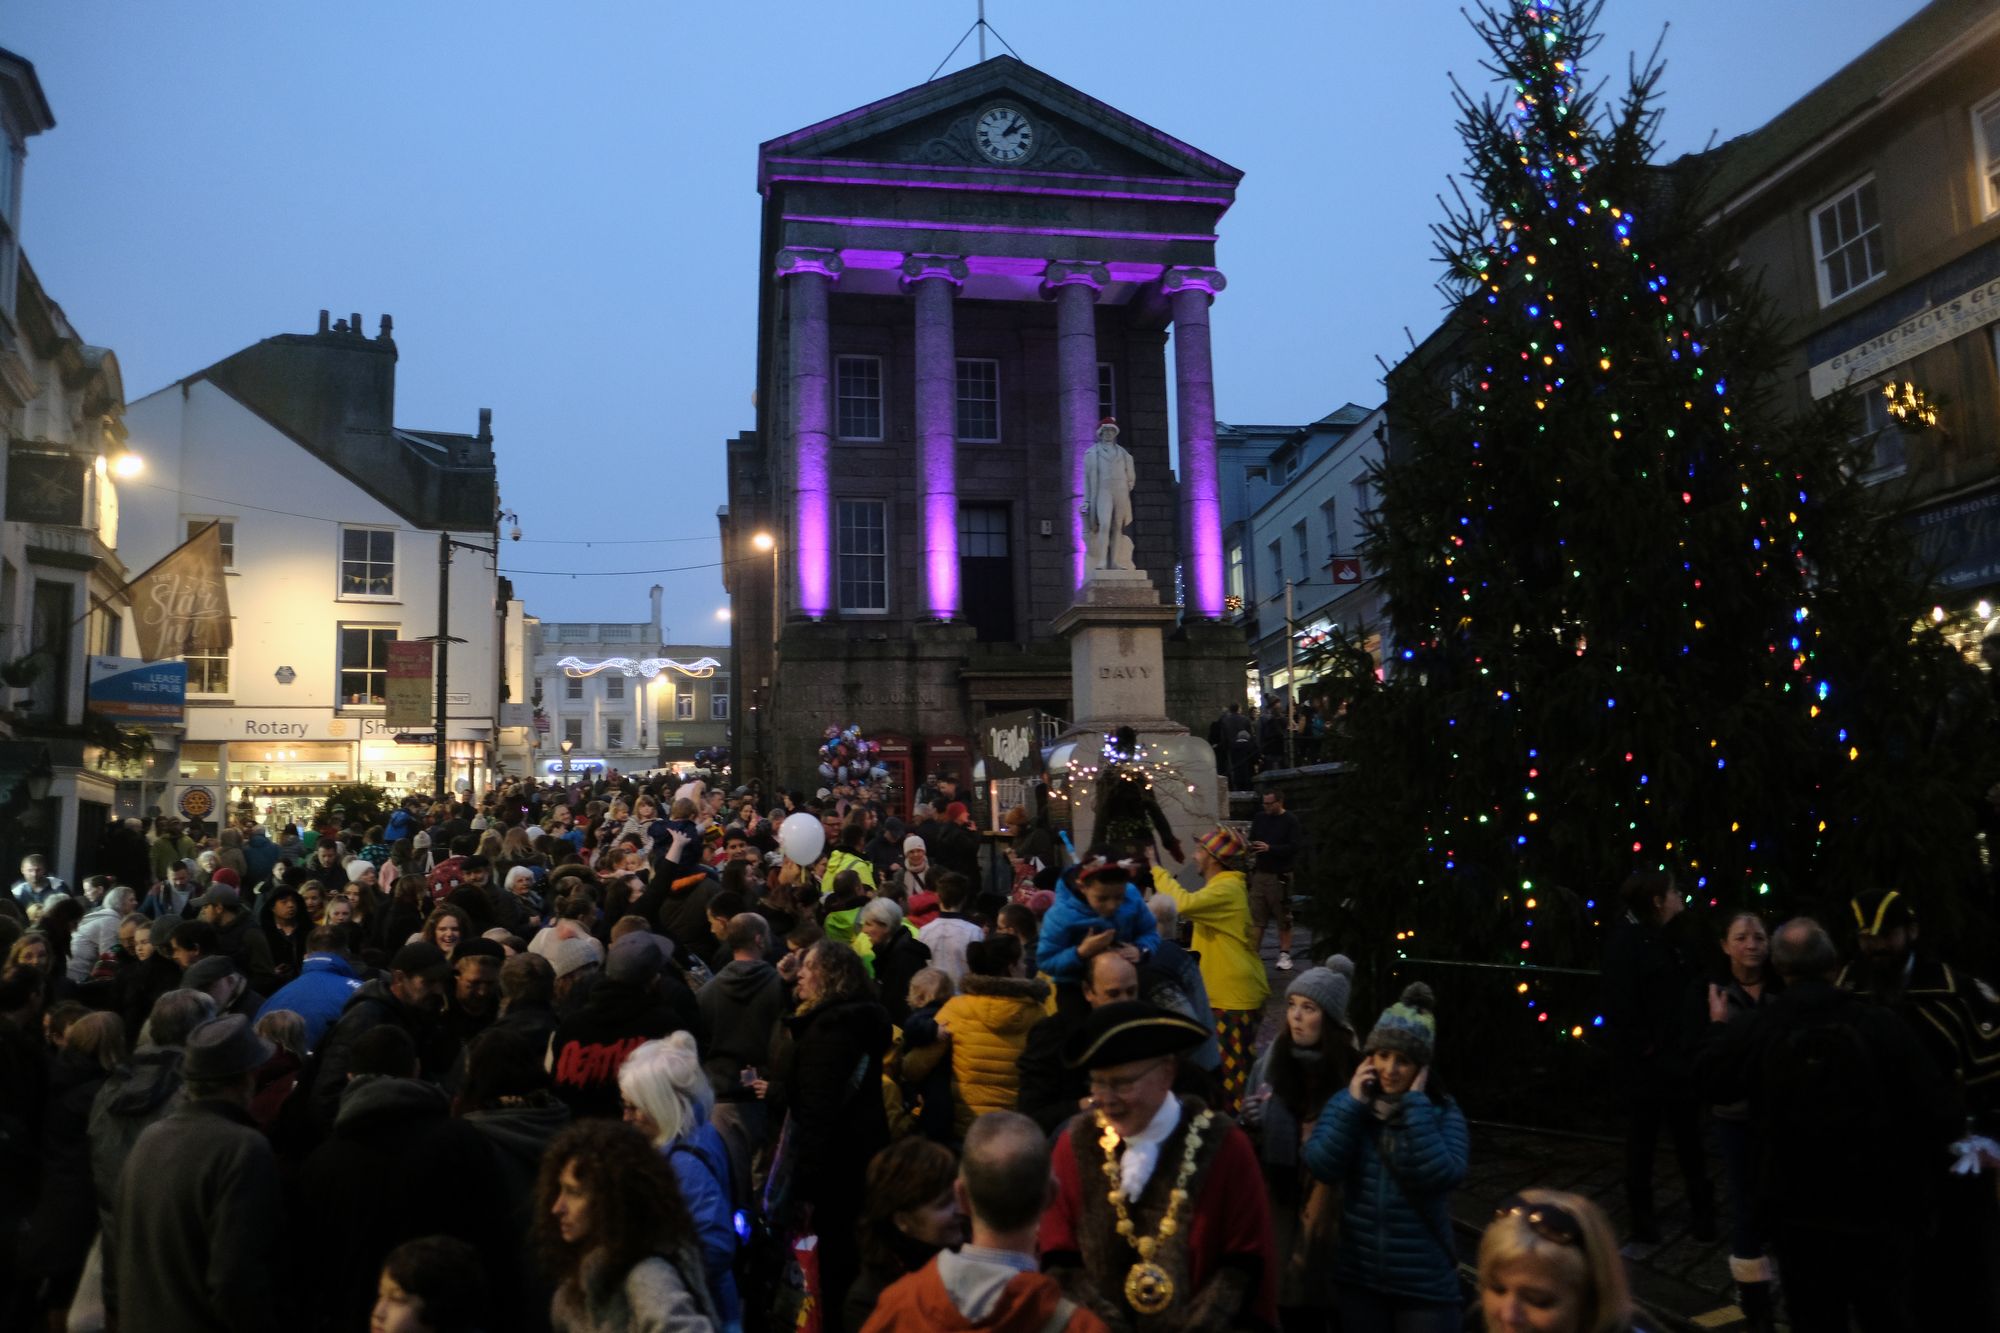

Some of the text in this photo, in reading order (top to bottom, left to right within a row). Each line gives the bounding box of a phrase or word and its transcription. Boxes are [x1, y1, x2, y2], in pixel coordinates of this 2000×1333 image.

[150, 672, 182, 683] LEASE
[1099, 666, 1152, 679] DAVY
[132, 681, 182, 693] THIS PUB
[245, 719, 309, 738] Rotary
